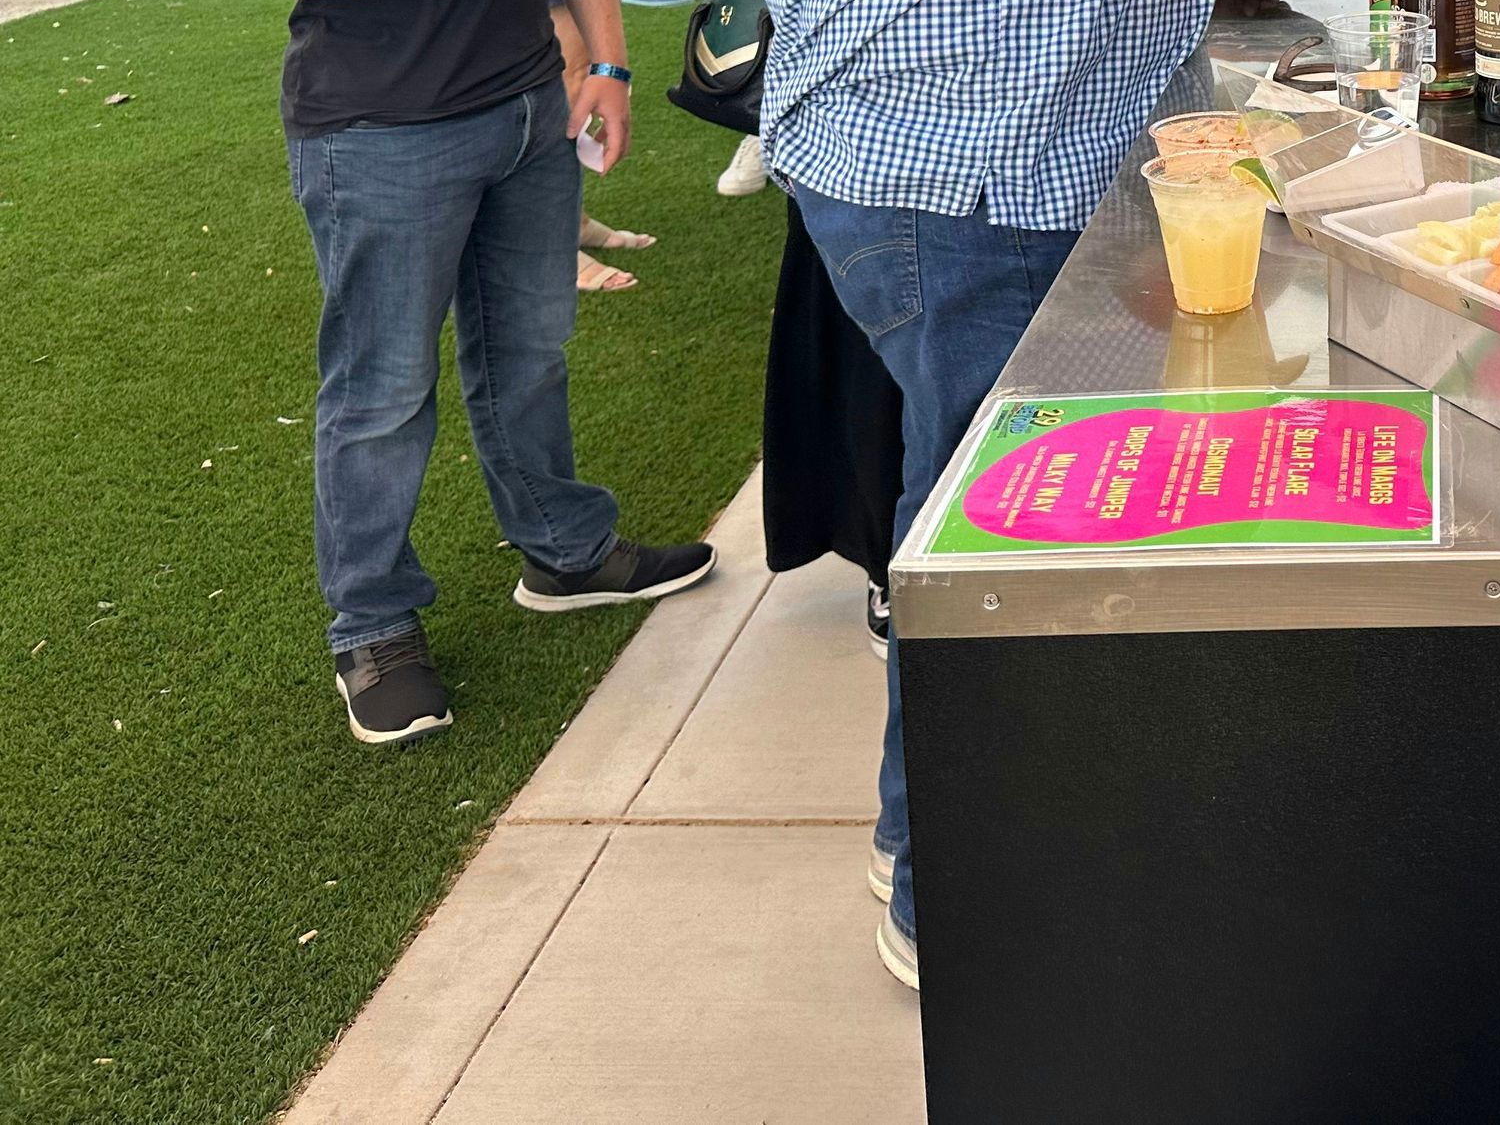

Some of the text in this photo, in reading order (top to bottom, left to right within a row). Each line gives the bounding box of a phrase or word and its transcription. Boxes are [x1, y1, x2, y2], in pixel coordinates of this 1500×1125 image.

[1034, 409, 1065, 426] 29
[1119, 425, 1154, 456] DROPS
[1026, 452, 1079, 513] MILKY WAY
[1113, 458, 1140, 471] OF
[1195, 437, 1234, 496] COSMONAUT
[1283, 427, 1319, 496] SOLAR FLARE
[1367, 425, 1399, 504] LIFE ON MARGS
[1096, 474, 1137, 519] JUNIPER
